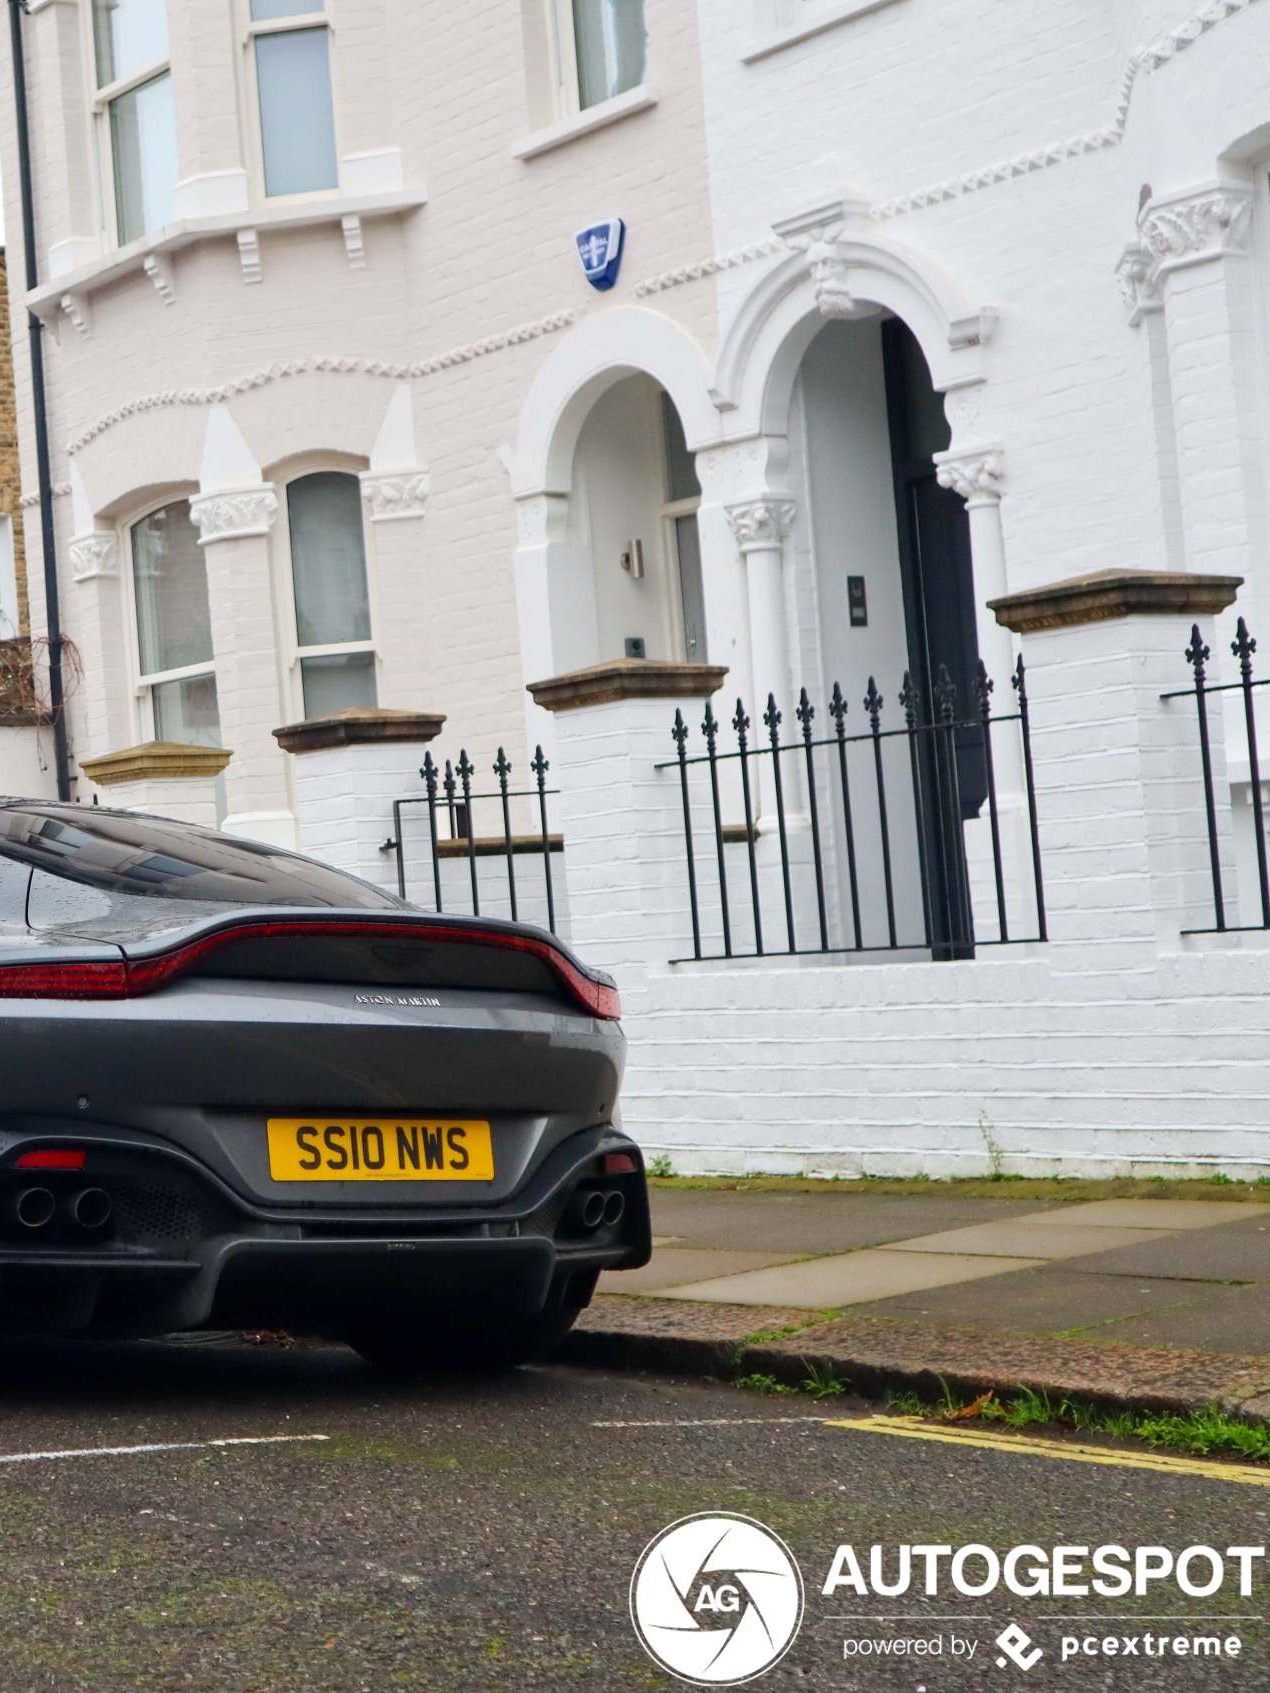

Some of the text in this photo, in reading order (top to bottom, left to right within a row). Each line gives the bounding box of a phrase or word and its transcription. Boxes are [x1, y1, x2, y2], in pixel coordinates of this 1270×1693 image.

[354, 994, 441, 1007] ASTON MARTIN
[296, 1126, 470, 1170] SS10 NWS
